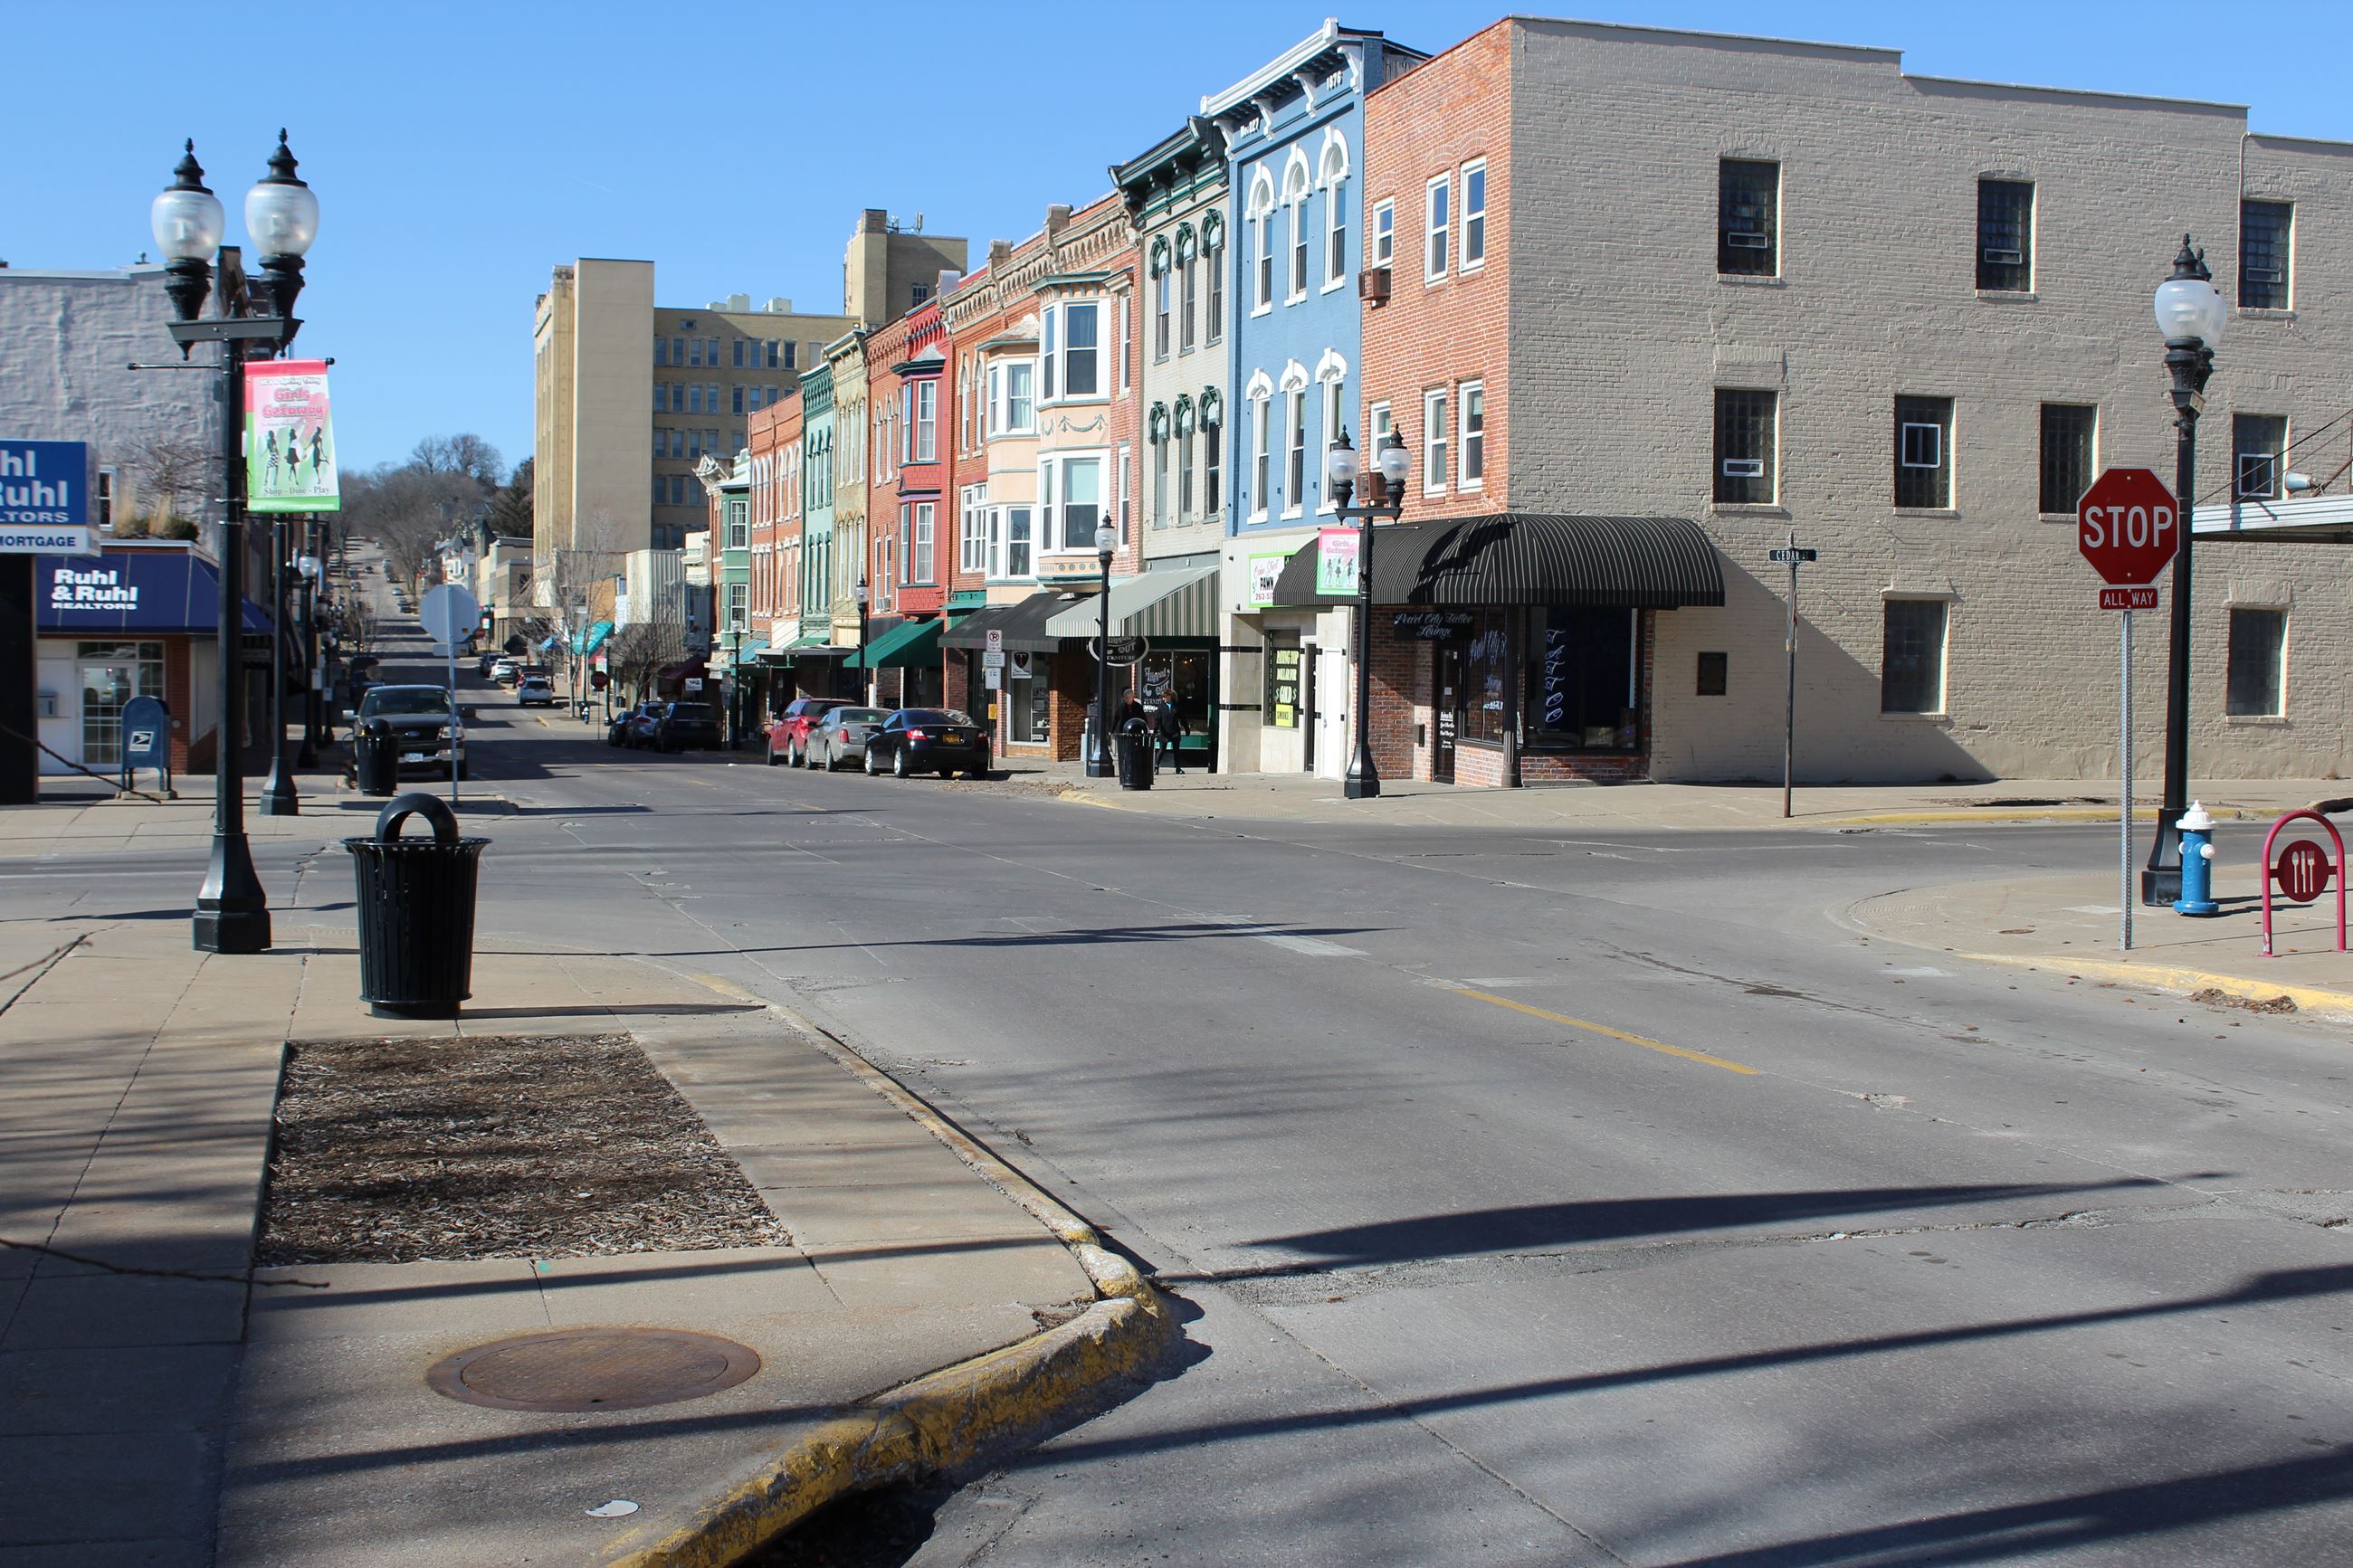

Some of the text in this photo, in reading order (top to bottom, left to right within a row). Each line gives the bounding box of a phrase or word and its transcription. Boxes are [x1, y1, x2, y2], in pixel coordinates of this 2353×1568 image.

[274, 387, 310, 402] Girls
[262, 404, 324, 420] Getaway
[313, 486, 329, 495] Play
[2084, 506, 2173, 547] STOP
[1776, 550, 1800, 561] CEDAR
[54, 569, 118, 584] Ruhl
[1260, 576, 1274, 591] PAWN
[1255, 593, 1274, 601] 263-57
[2103, 592, 2154, 606] ALL WAY
[52, 603, 137, 611] REALTORS
[1394, 612, 1473, 628] Pearl City Tattoo
[1415, 624, 1453, 640] Lounge
[1544, 629, 1566, 723] TATTOO
[1280, 685, 1292, 703] GOLD
[1276, 710, 1290, 721] SMOKE
